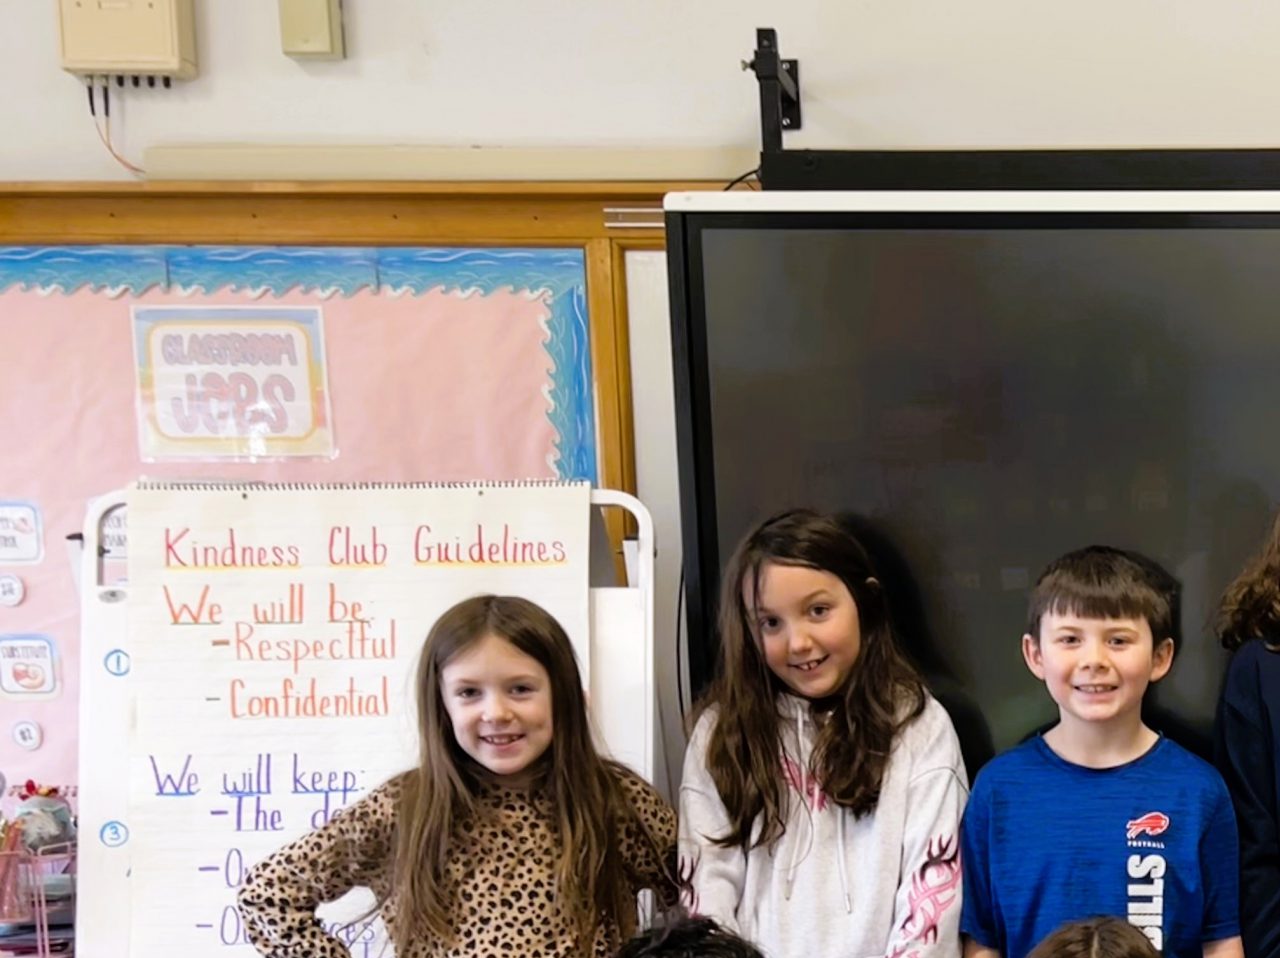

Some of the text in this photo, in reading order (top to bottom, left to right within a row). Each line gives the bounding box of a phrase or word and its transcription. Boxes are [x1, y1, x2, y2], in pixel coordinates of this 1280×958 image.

[170, 372, 296, 434] JOBS
[164, 525, 567, 567] Kindness Club Guidelines
[163, 585, 222, 624] We
[254, 583, 304, 624] will
[150, 754, 200, 795] We
[221, 753, 272, 796] will
